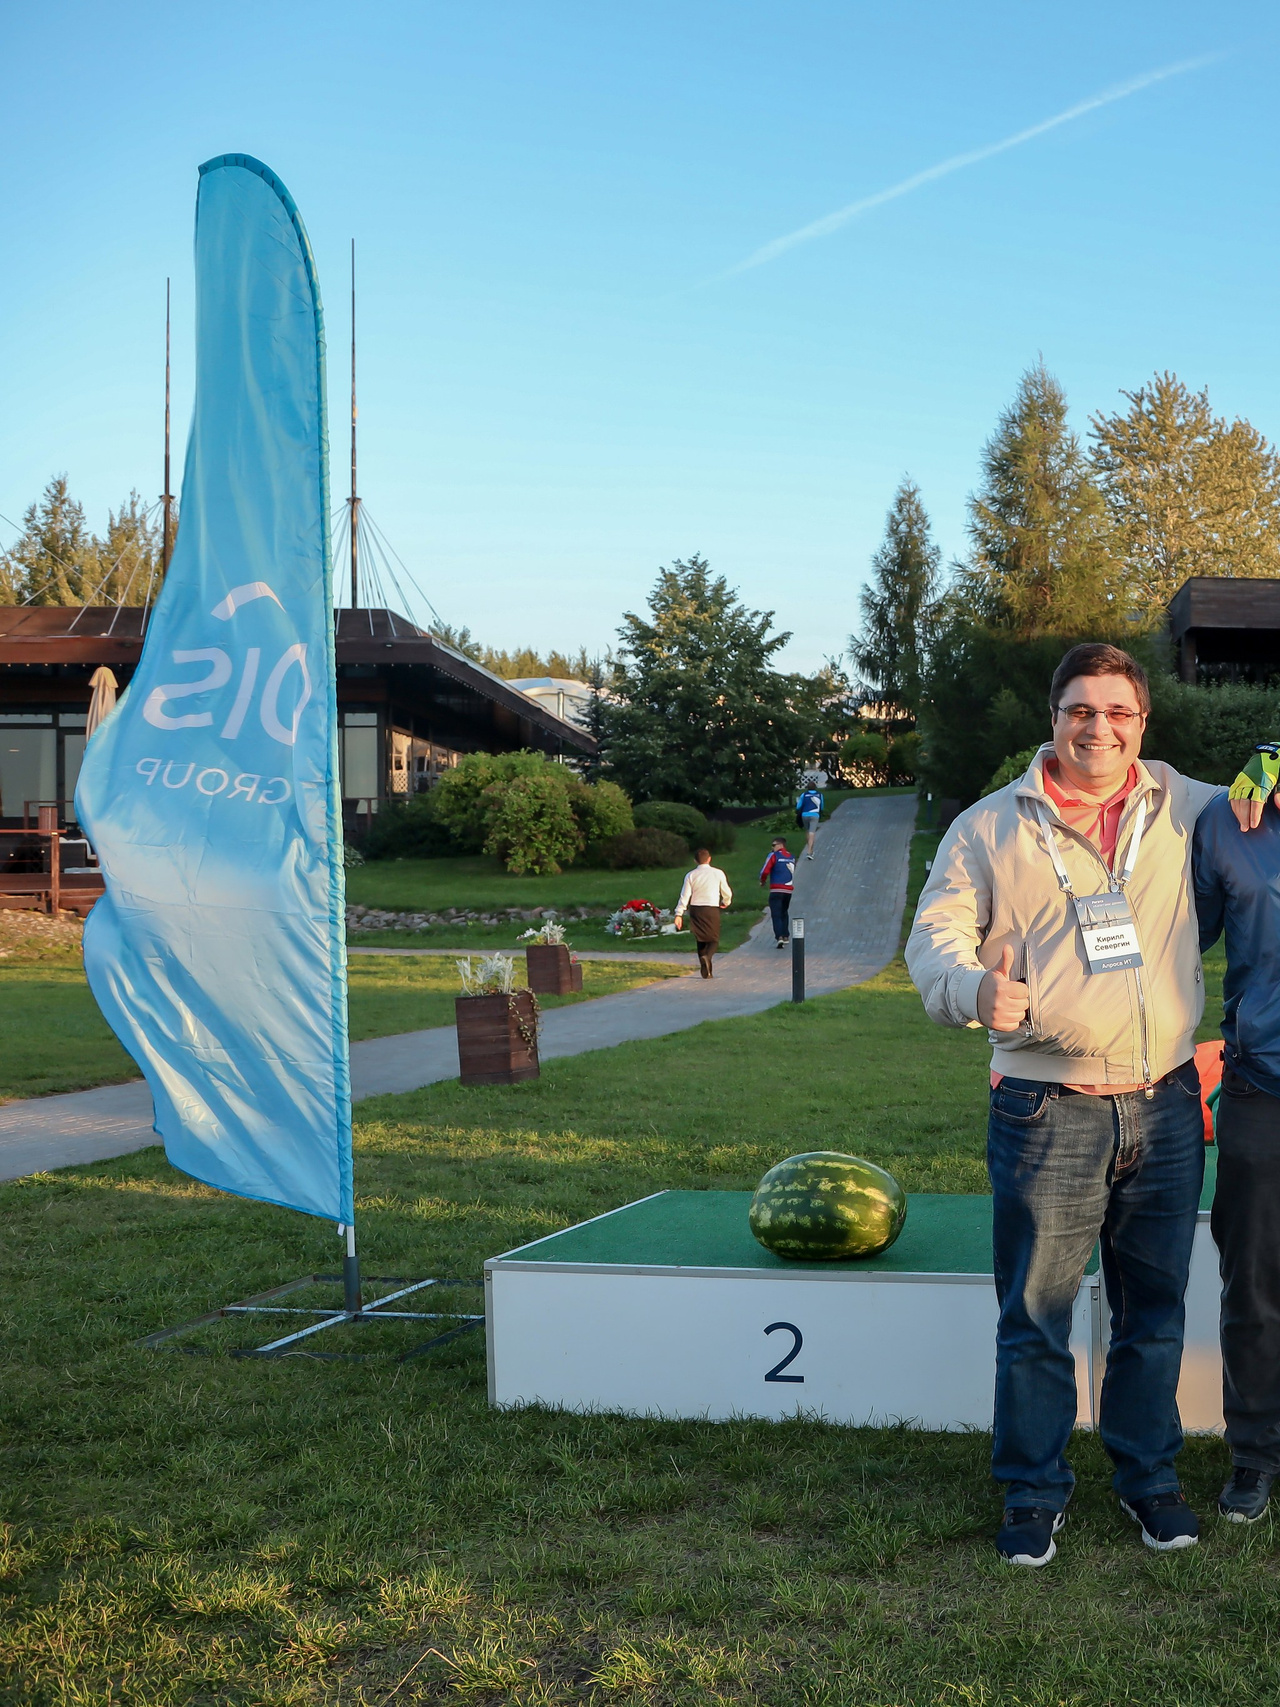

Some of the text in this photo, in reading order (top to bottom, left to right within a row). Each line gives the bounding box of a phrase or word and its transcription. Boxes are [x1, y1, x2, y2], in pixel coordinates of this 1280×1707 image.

[1096, 933, 1125, 943] Кирилл
[1094, 941, 1131, 952] Севергин
[763, 1321, 805, 1382] 2
